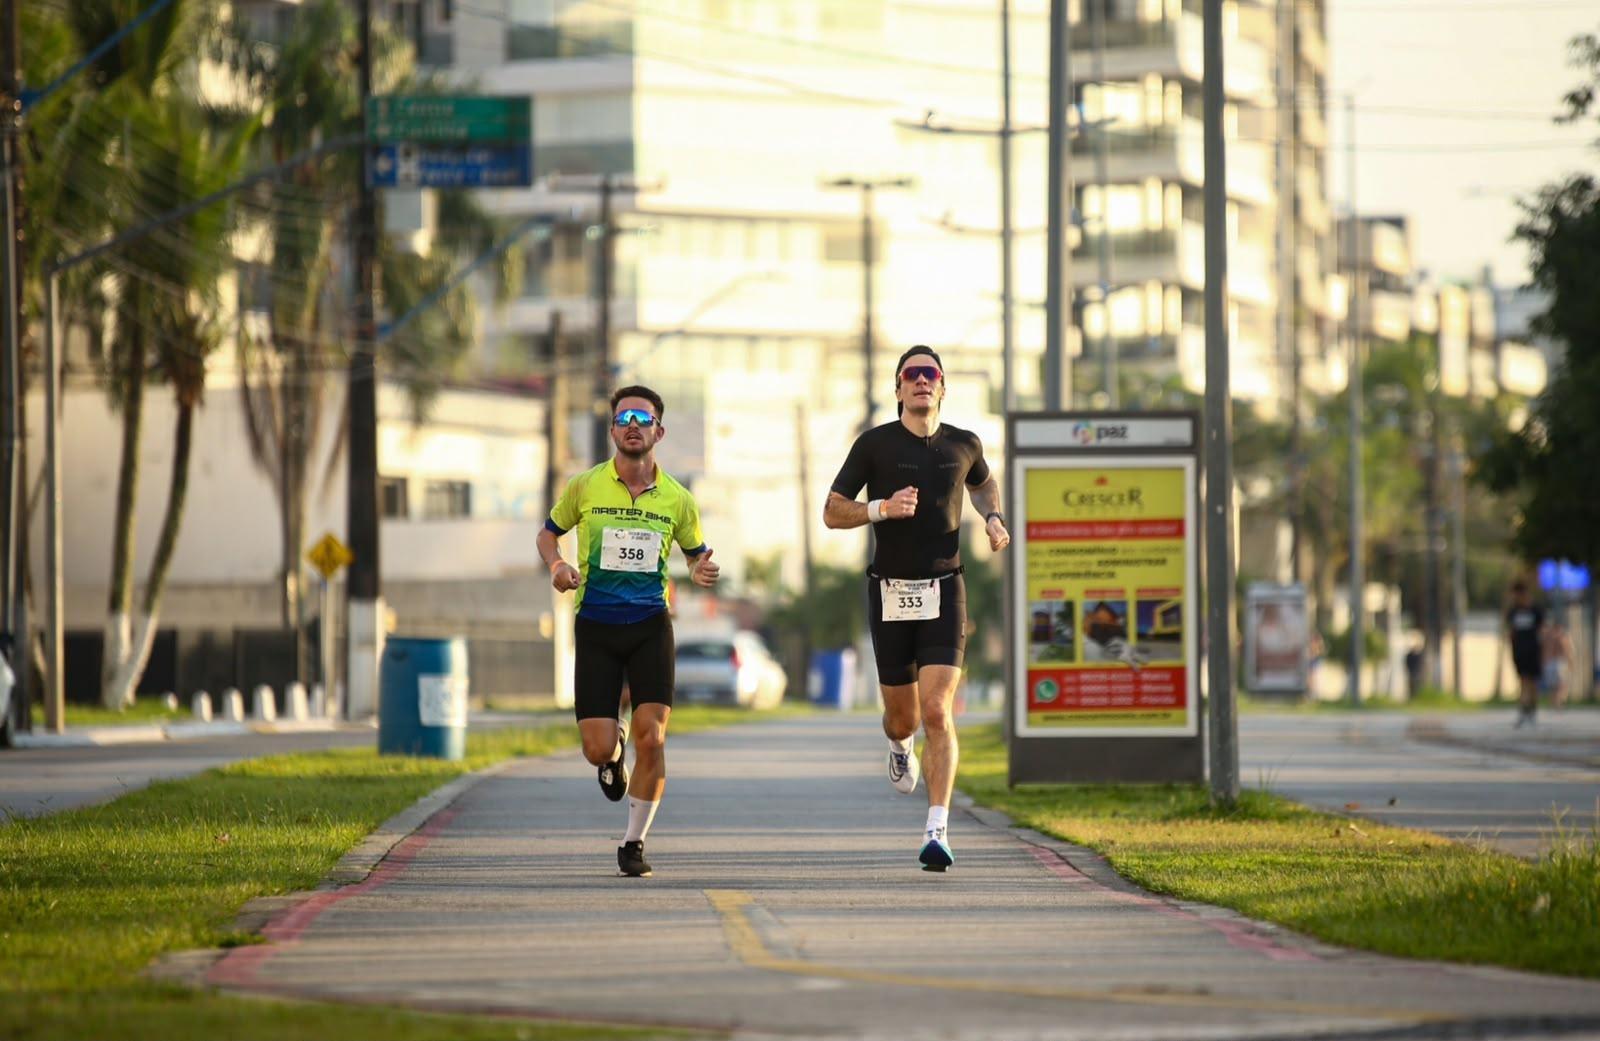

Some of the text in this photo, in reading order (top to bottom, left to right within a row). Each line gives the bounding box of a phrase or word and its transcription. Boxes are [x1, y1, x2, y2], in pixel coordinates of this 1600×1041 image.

[1096, 426, 1127, 442] paz
[592, 507, 642, 516] MASTER
[645, 511, 671, 524] BIKE
[618, 548, 645, 561] 358
[898, 596, 922, 609] 333
